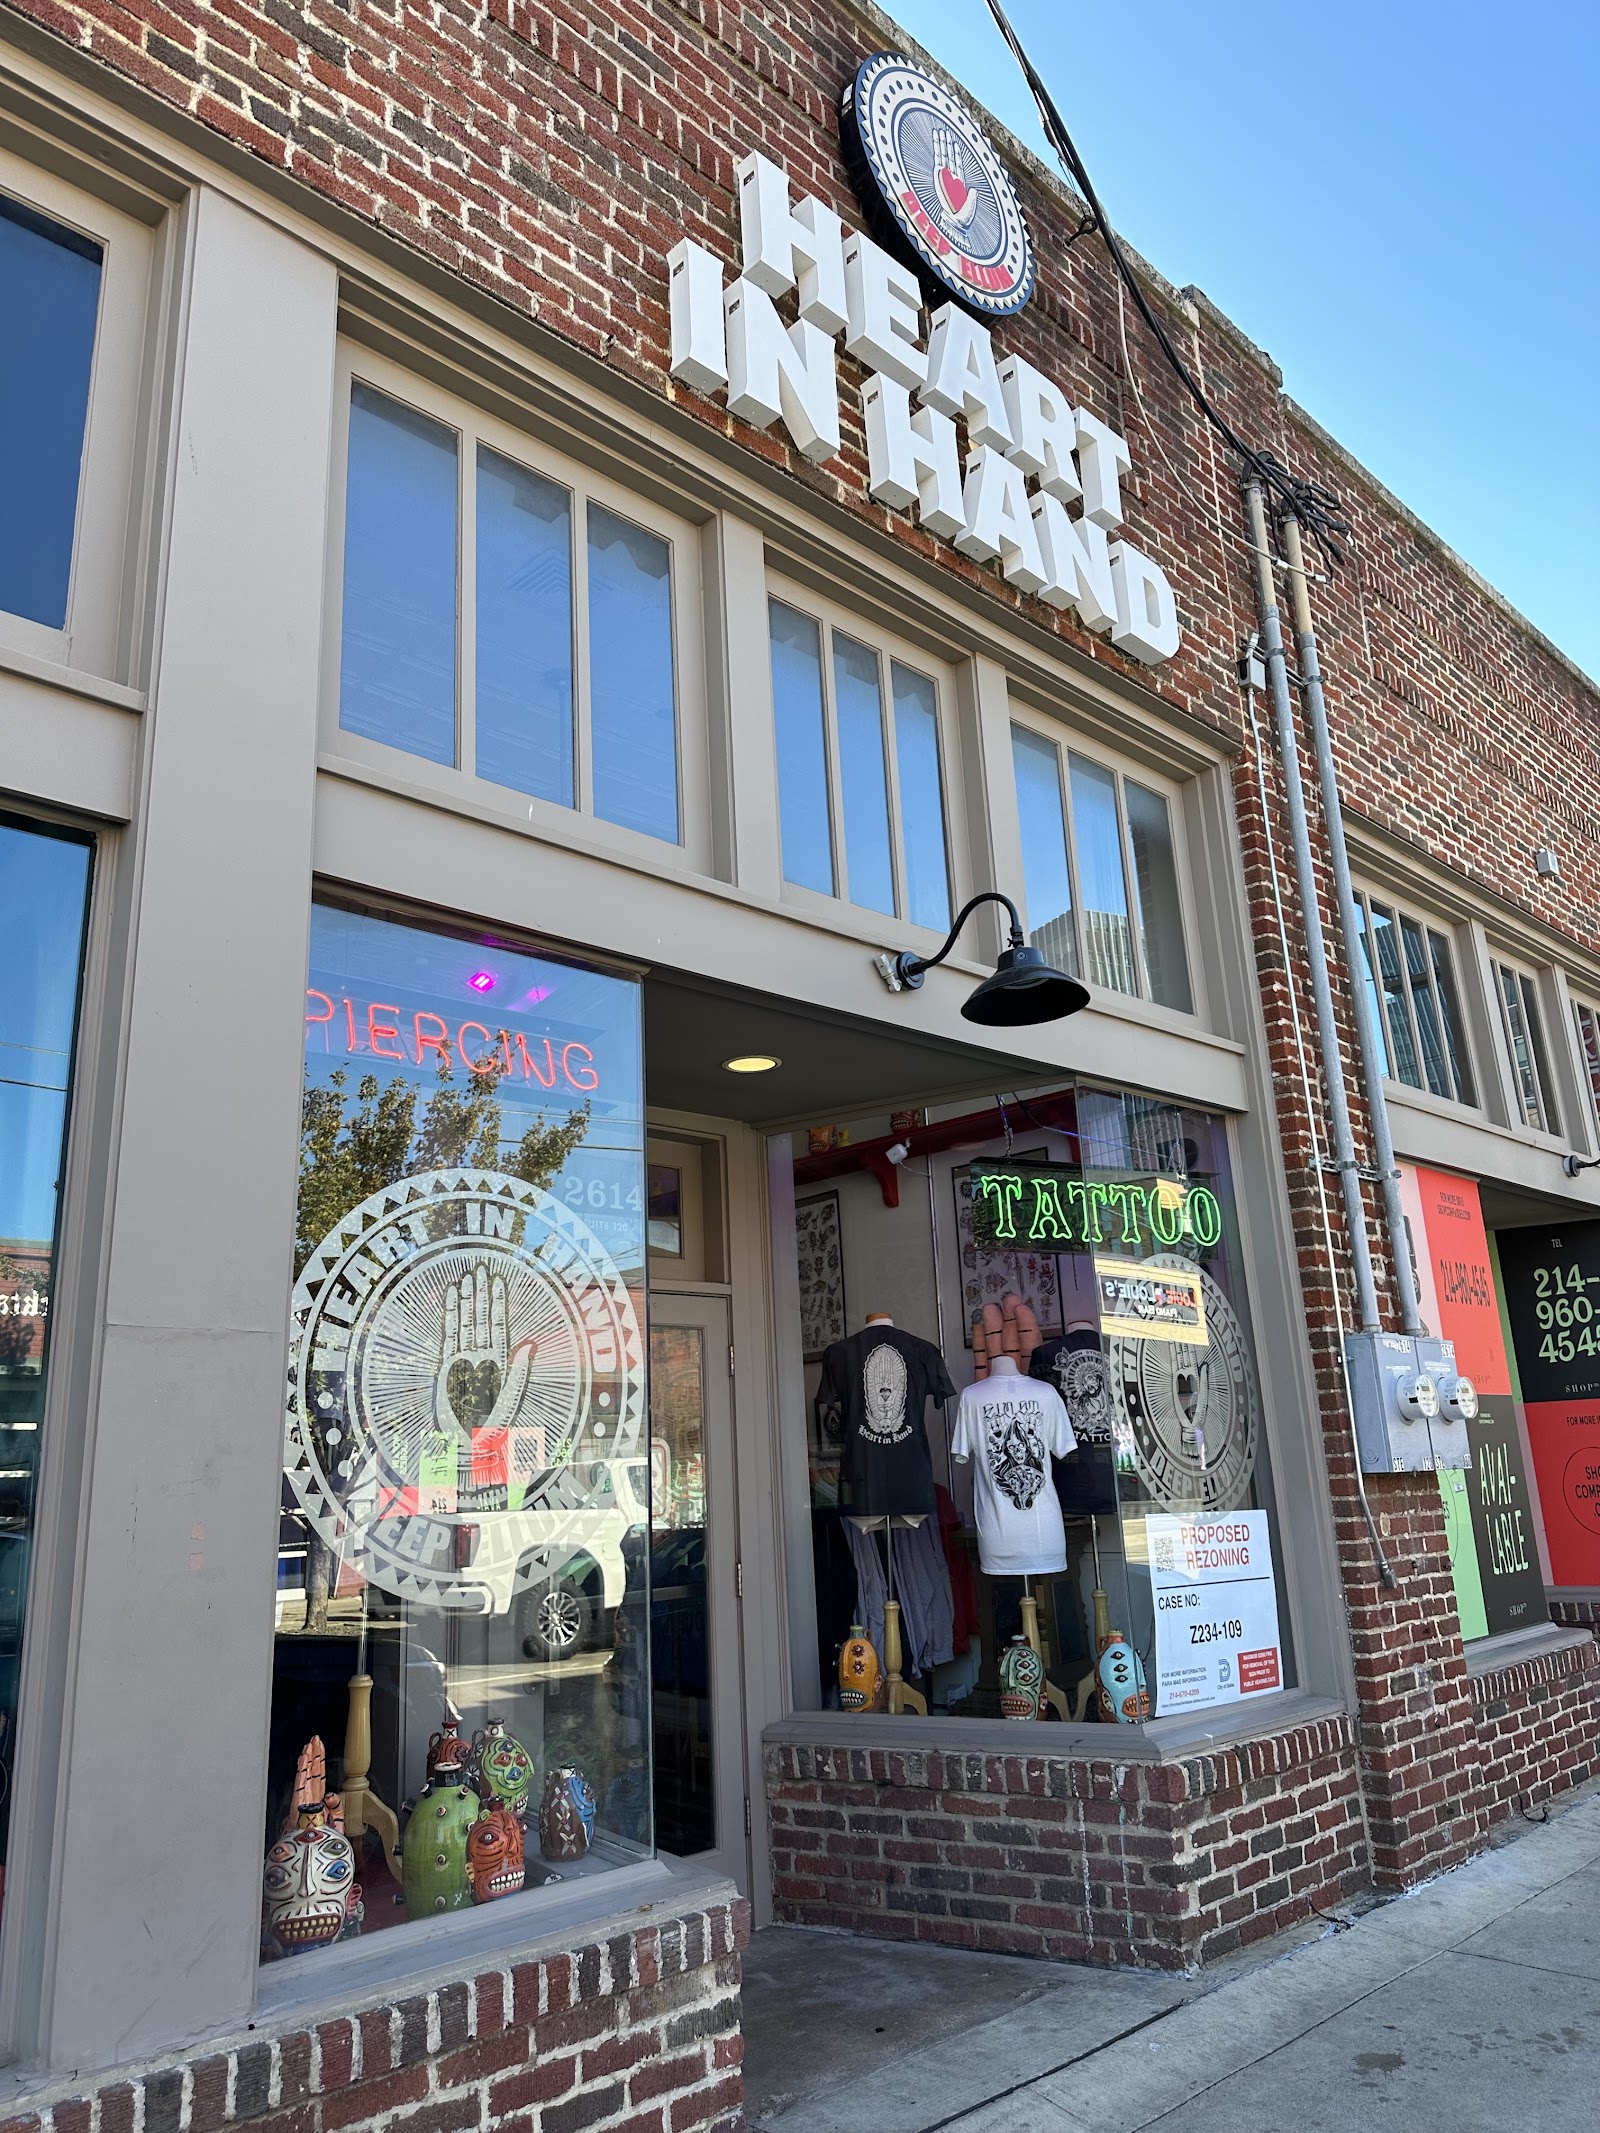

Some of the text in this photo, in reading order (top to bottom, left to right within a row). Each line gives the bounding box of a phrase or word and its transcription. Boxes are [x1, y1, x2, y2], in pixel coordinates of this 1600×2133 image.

[900, 190, 1015, 291] DEEP ELLUM
[737, 150, 1130, 531] HEART
[666, 237, 1179, 666] IN HAND
[305, 988, 600, 1091] PIERCING
[564, 1176, 642, 1211] 2614
[981, 1174, 1222, 1248] TATTOO
[1551, 1239, 1563, 1248] TEL
[313, 1202, 617, 1373] HEART IN HAND
[1533, 1264, 1600, 1298] 214-
[1535, 1296, 1600, 1330] 960-
[1204, 1293, 1245, 1382] HAND
[1538, 1325, 1600, 1363] 454
[1565, 1383, 1594, 1393] SHOP
[1074, 1430, 1111, 1443] TATTO
[1567, 1416, 1578, 1425] FOR
[1579, 1415, 1596, 1425] MORE
[1149, 1444, 1243, 1503] DEEP ELLUM
[370, 1510, 452, 1565] EEP
[1181, 1524, 1250, 1545] PROPOSED
[1486, 1509, 1529, 1575] LABLE
[1186, 1547, 1249, 1569] REZONING
[1158, 1594, 1200, 1610] CASE NO:
[1190, 1619, 1242, 1644] Z234-109
[1161, 1667, 1207, 1679] FOR MORE INFORMATION
